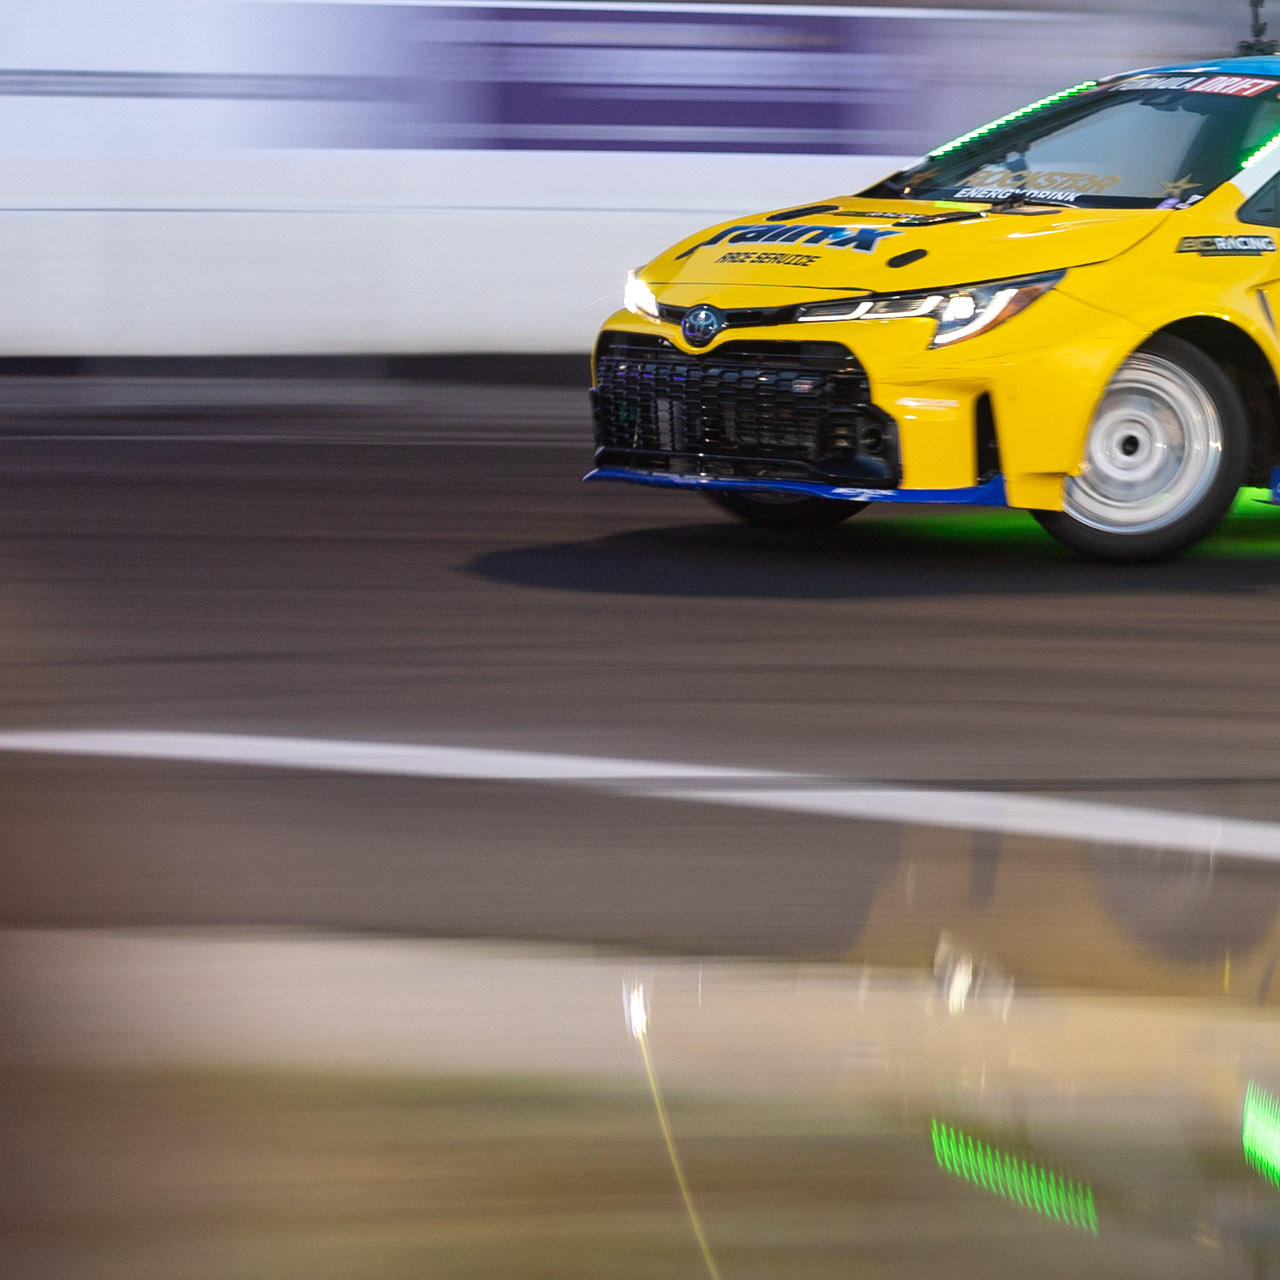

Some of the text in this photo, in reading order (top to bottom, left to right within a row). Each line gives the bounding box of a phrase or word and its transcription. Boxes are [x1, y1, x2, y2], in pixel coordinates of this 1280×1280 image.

[1193, 76, 1279, 96] DRIFT
[954, 170, 1121, 194] ROCKSTAR
[1214, 236, 1277, 251] RACING
